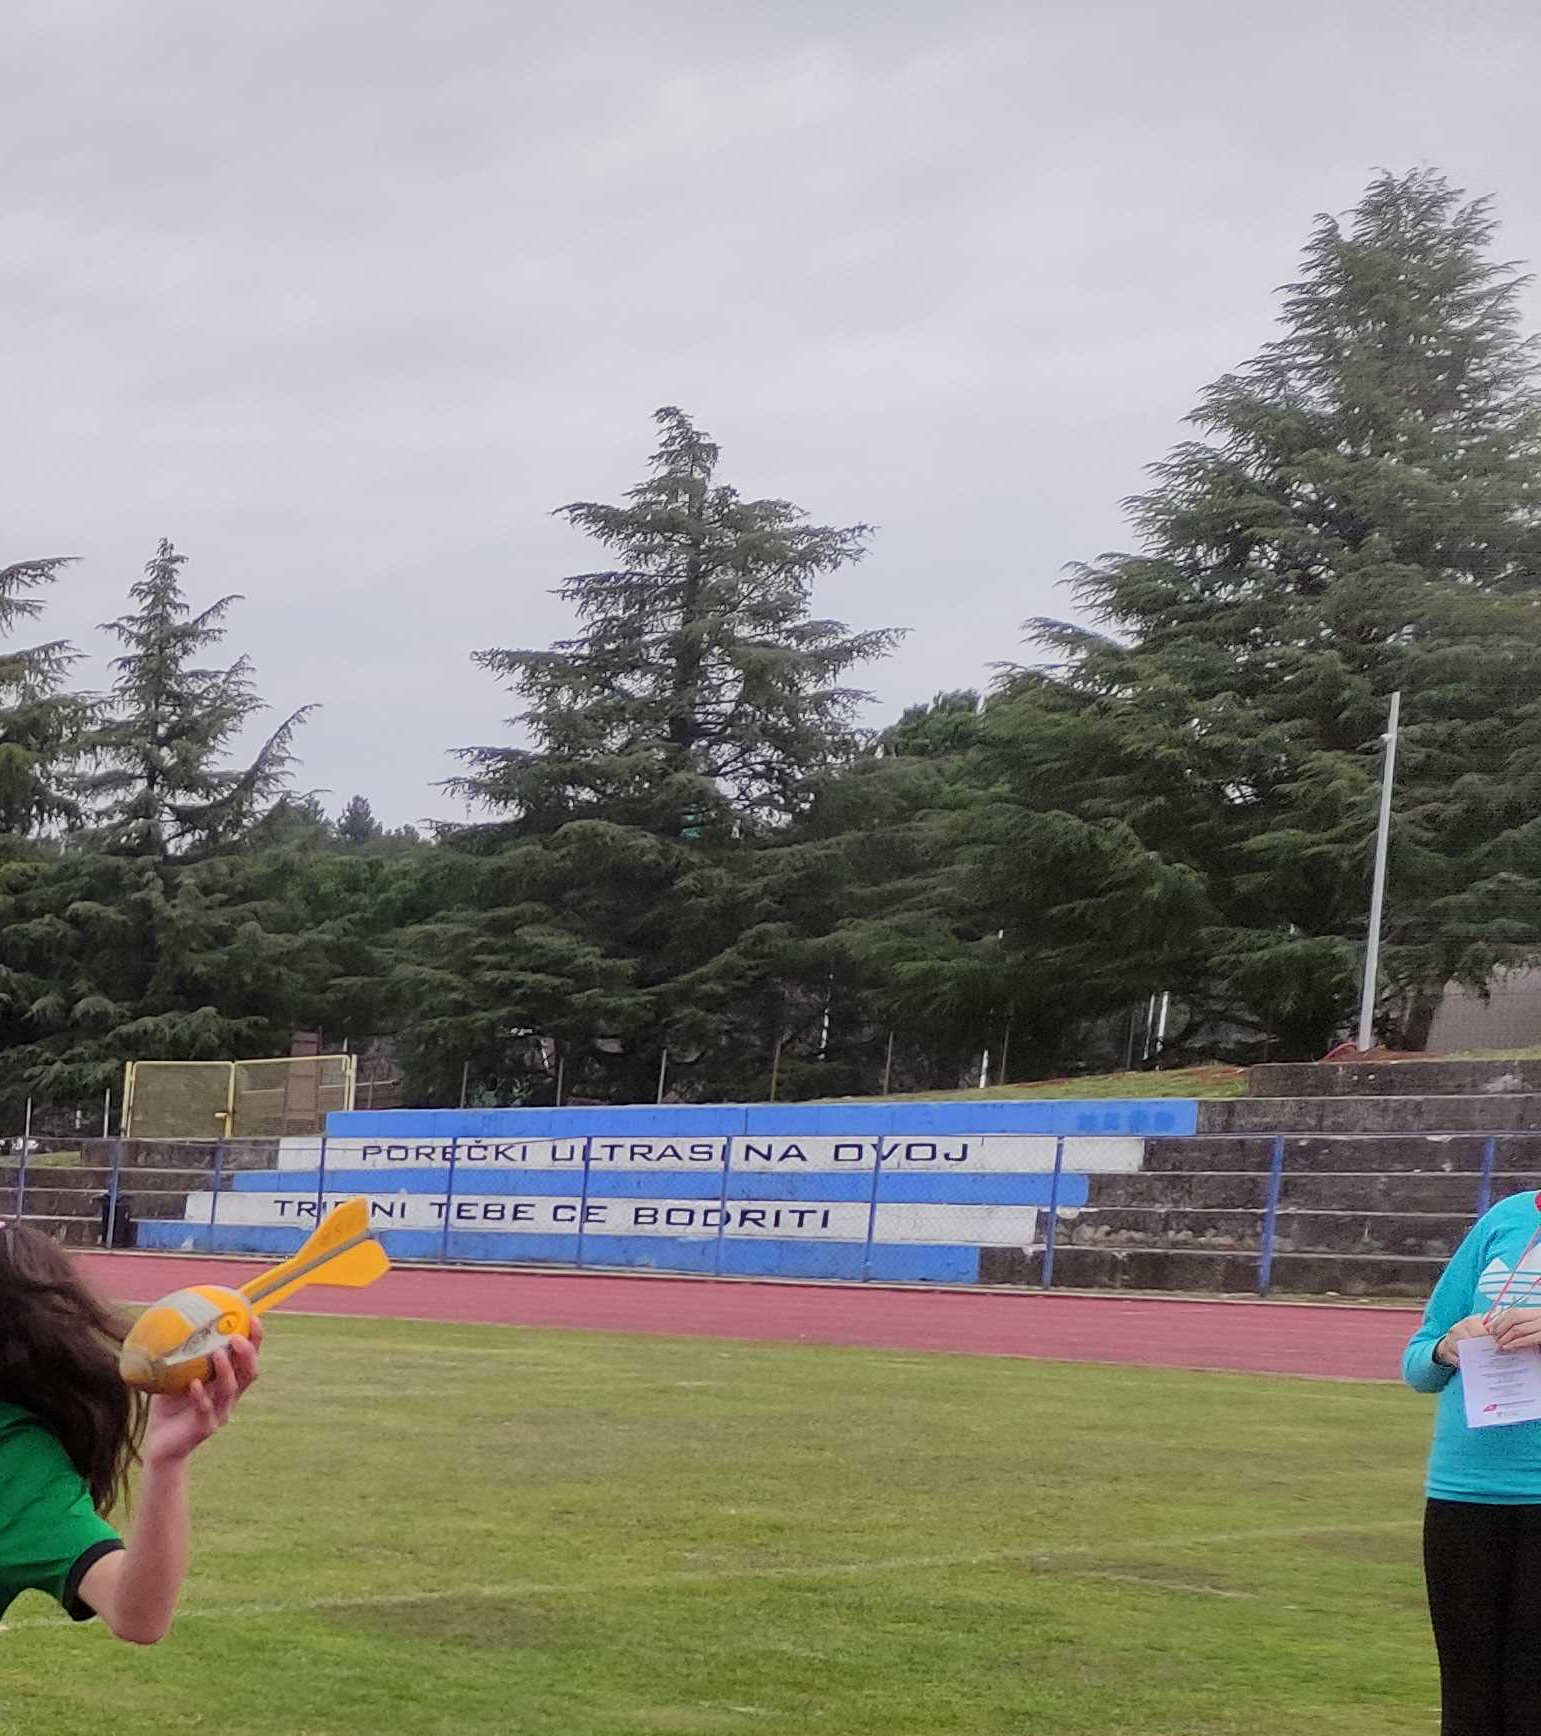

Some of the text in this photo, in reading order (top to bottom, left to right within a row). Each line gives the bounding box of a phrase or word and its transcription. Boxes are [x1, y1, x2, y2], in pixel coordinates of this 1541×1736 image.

[362, 1139, 527, 1162] POREČKI
[744, 1143, 809, 1162] NA
[833, 1142, 968, 1162] OVOJ
[273, 1200, 406, 1219] TRINI
[429, 1202, 536, 1221] TEBE
[634, 1206, 829, 1229] BODRITI
